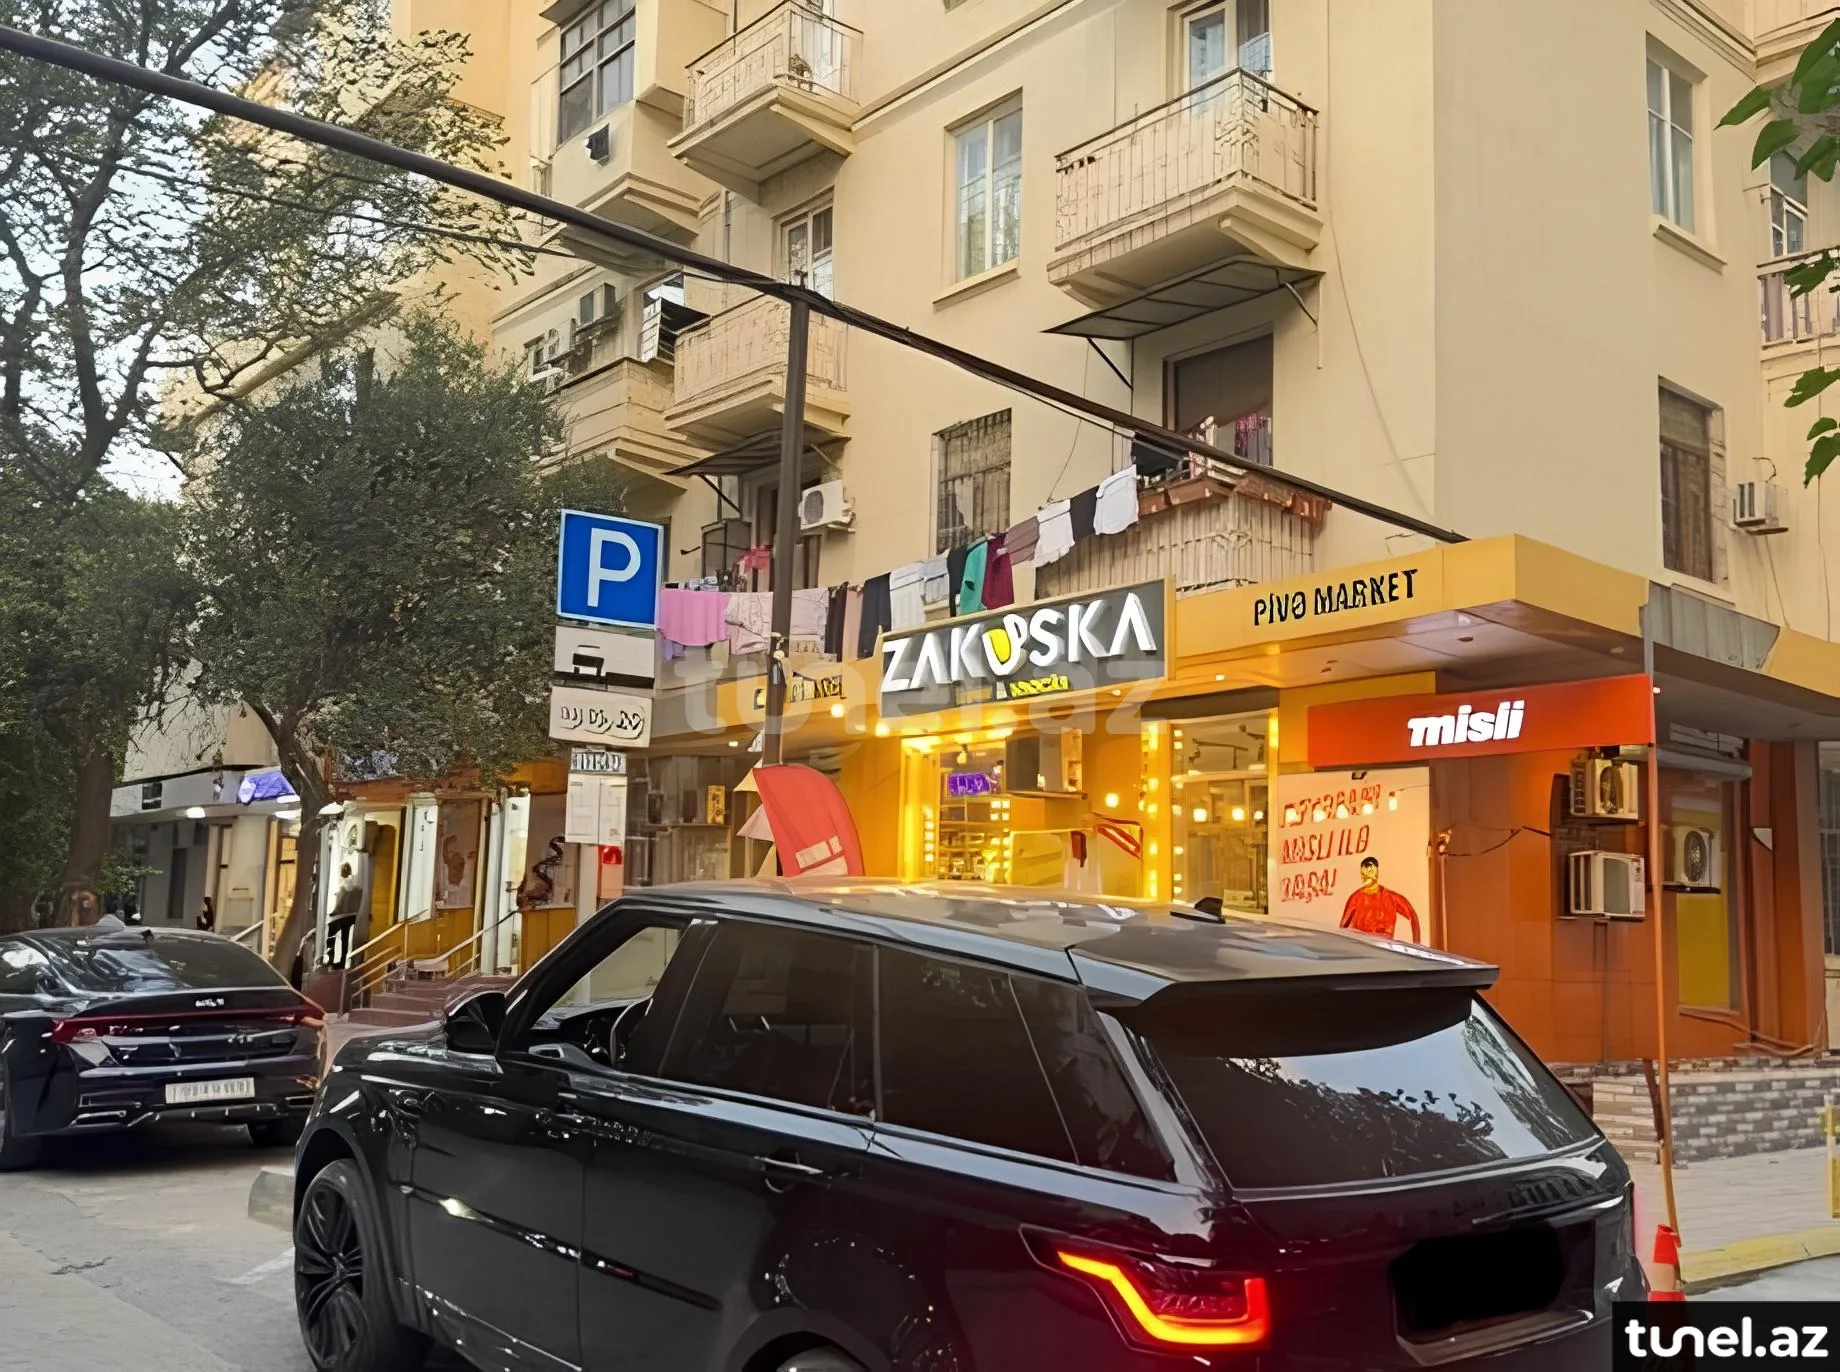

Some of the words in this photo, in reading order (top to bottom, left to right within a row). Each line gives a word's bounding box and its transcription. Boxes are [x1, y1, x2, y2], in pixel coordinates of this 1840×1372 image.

[587, 528, 641, 607] P
[1313, 568, 1419, 616] MARKET
[1407, 700, 1525, 748] misli
